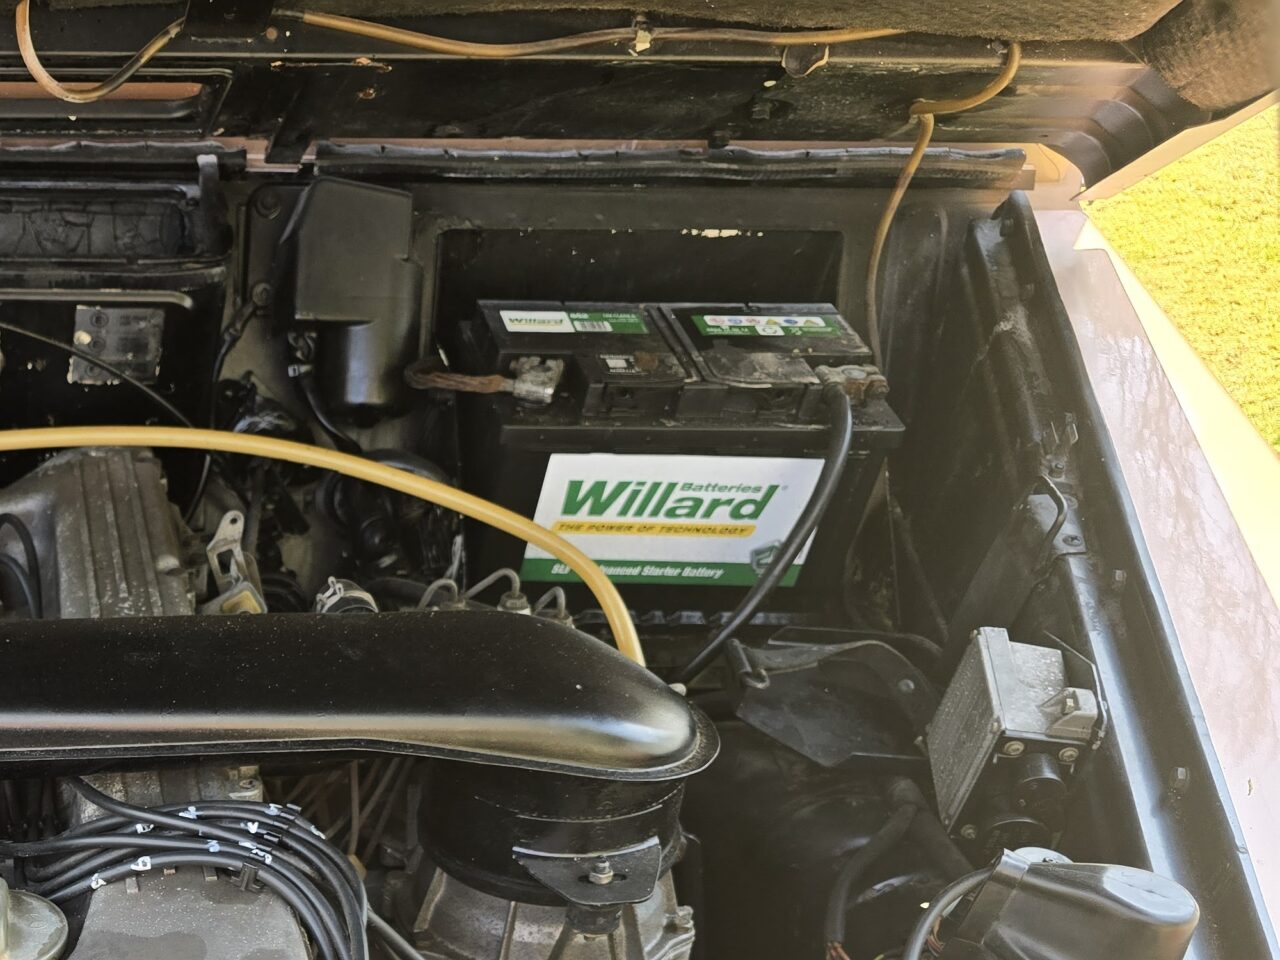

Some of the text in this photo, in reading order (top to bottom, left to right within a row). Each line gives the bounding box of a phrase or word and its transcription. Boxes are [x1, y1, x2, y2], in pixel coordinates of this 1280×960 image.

[679, 482, 762, 494] Batteries
[560, 479, 780, 521] Willard
[558, 523, 748, 535] THE POWER OF TECHNOLOGY
[641, 565, 681, 577] Starter
[681, 566, 725, 580] Battery
